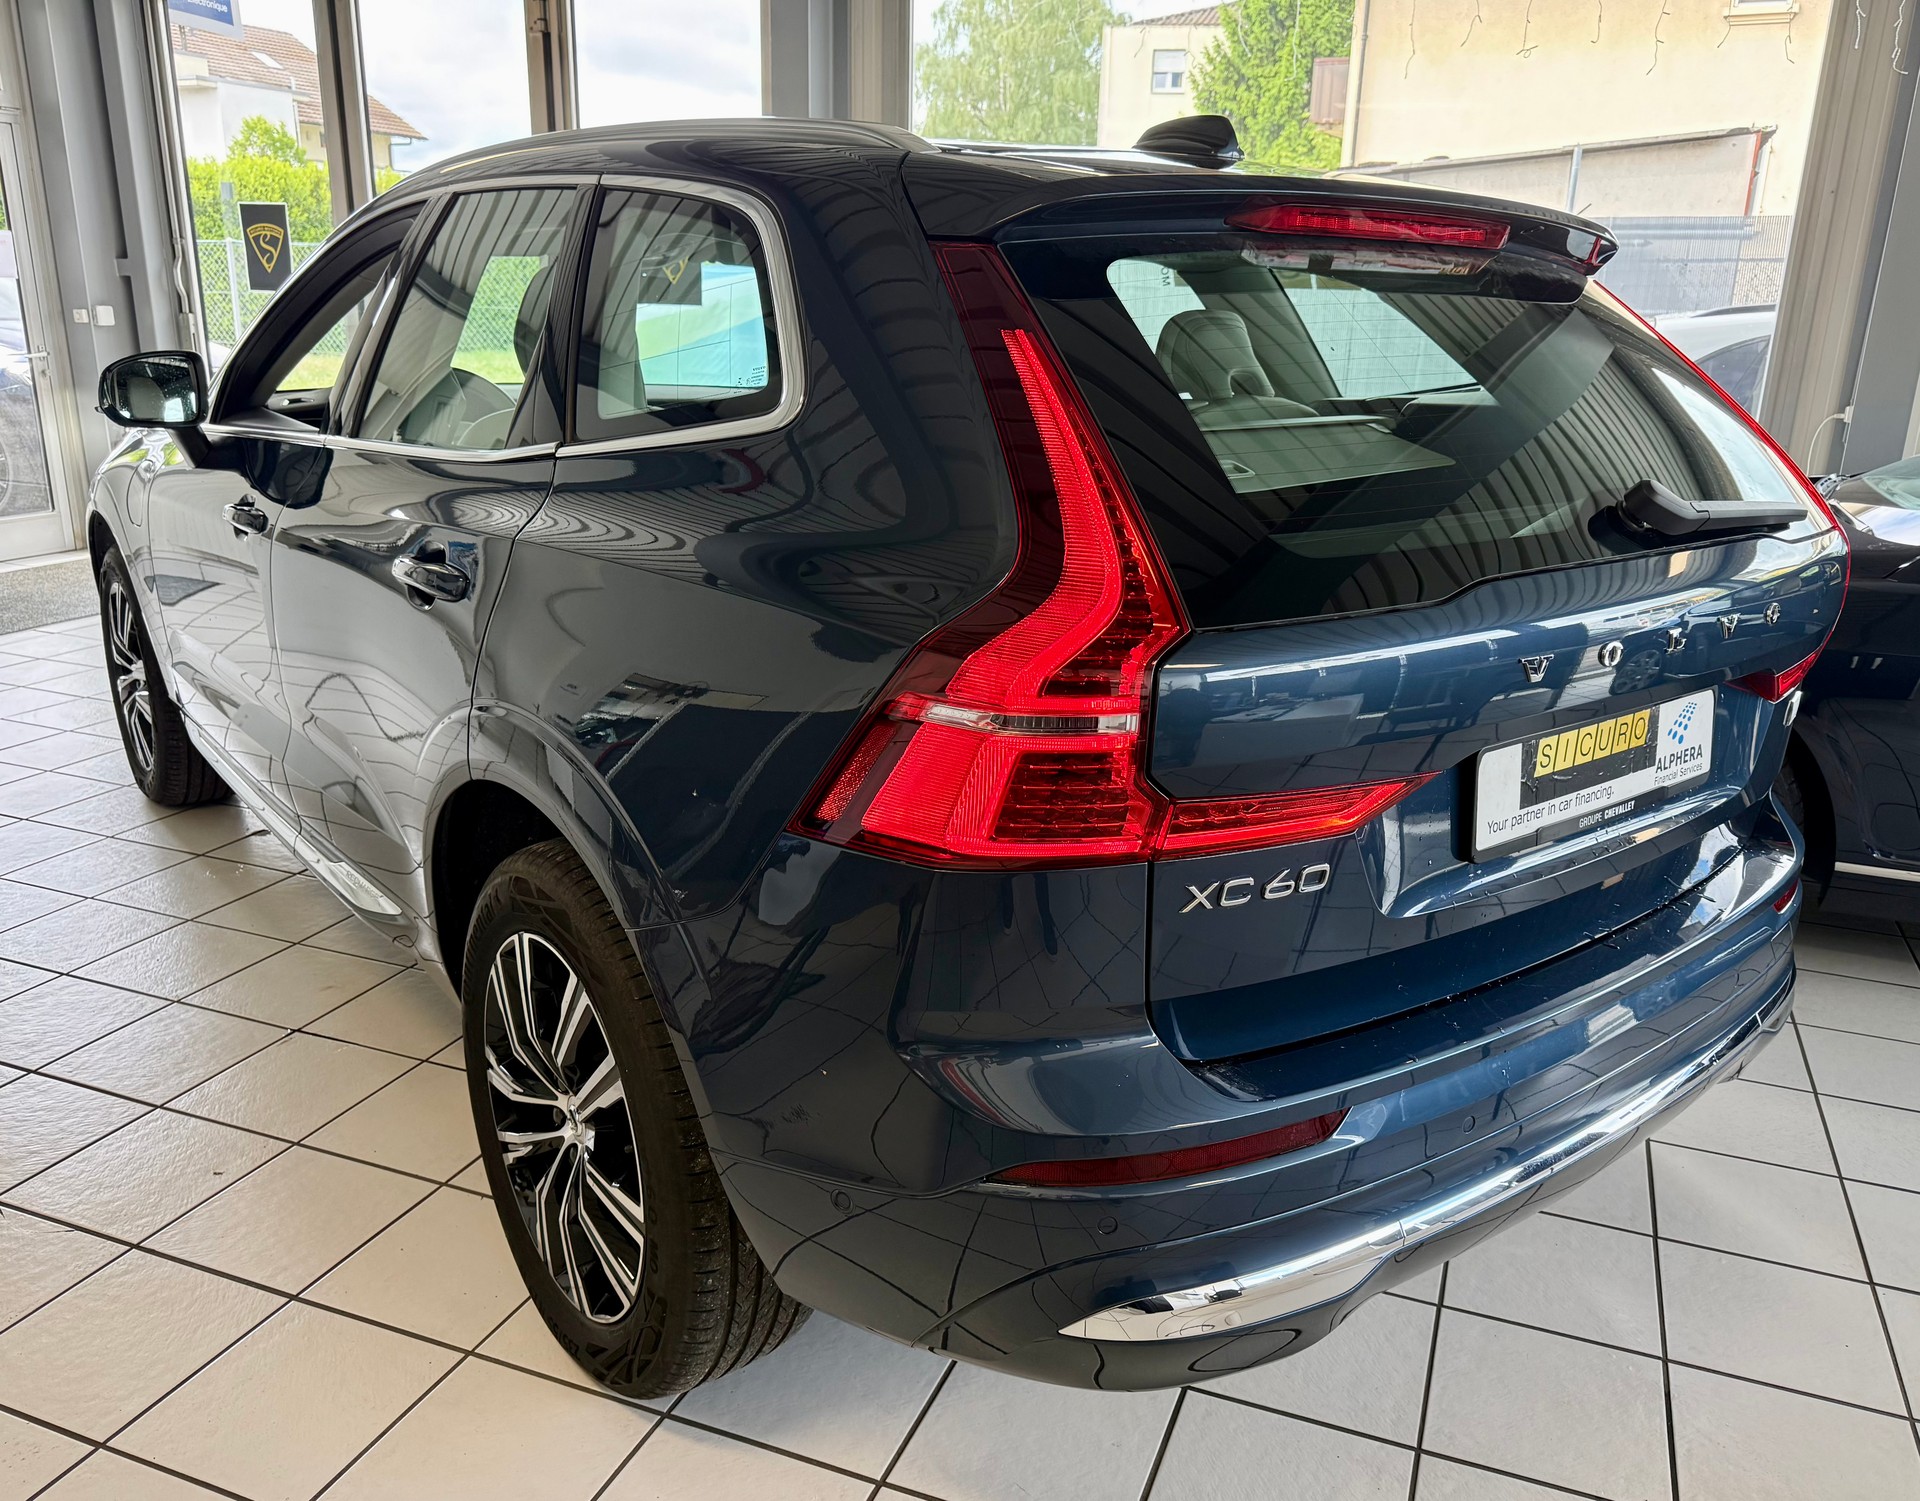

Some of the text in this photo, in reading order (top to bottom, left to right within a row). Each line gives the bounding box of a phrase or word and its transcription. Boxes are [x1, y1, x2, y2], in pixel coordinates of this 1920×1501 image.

[1518, 602, 1781, 683] VOLVO
[1539, 716, 1646, 769] SICURO
[1655, 743, 1703, 774] ALPHERA
[1653, 762, 1703, 787] Financial Services
[1487, 785, 1615, 835] Your partner in car financing.
[1579, 799, 1636, 828] GROUPE CHEVALLEY
